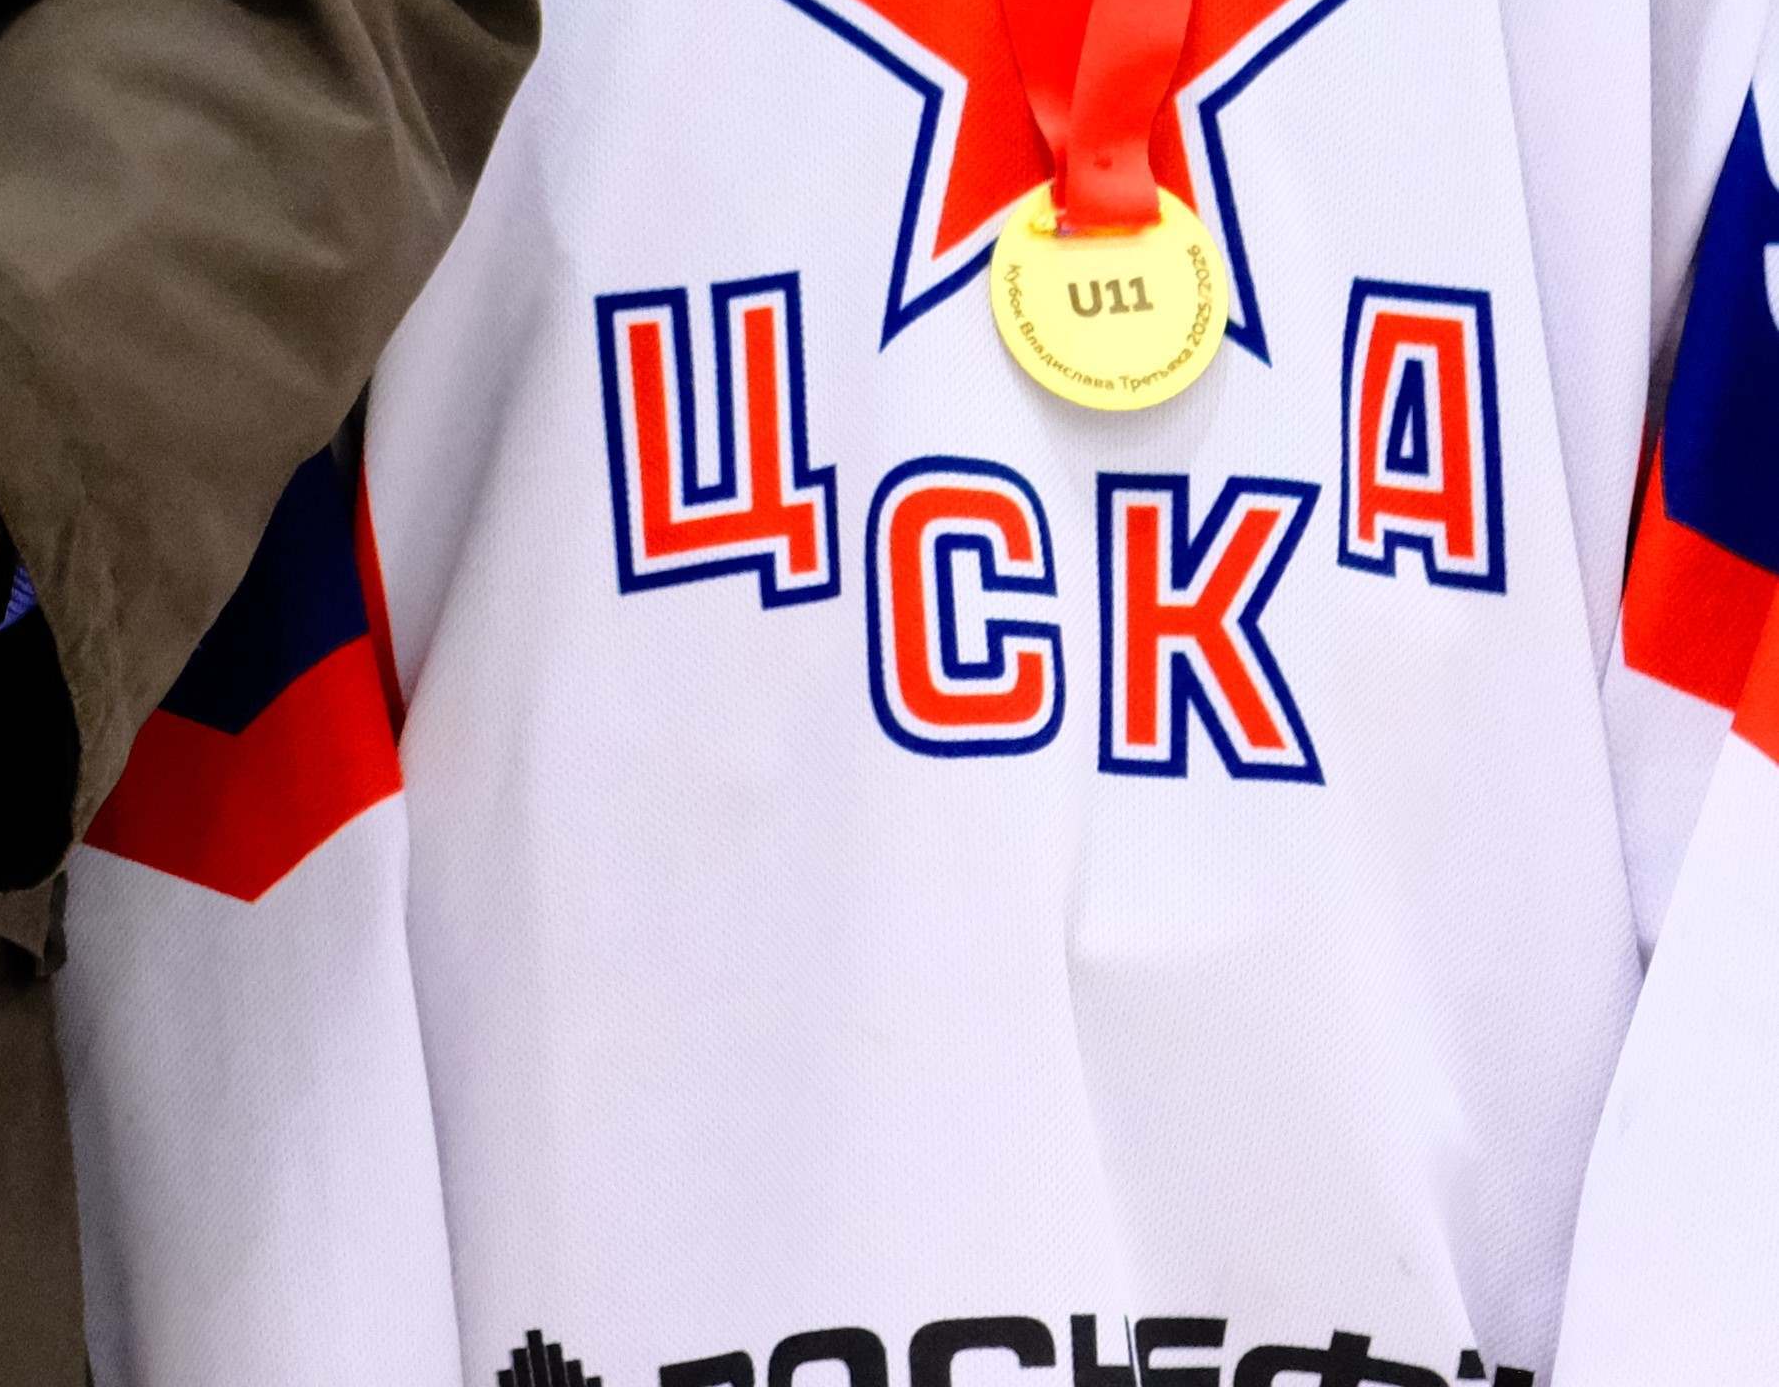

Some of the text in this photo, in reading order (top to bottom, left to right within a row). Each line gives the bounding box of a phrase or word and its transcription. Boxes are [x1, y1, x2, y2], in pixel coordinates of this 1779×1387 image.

[1003, 263, 1023, 319] Кубок
[1019, 321, 1115, 391] Владислава
[1117, 347, 1193, 393] Третьяка
[1067, 276, 1154, 318] U11
[594, 271, 1507, 787] ЦСКА
